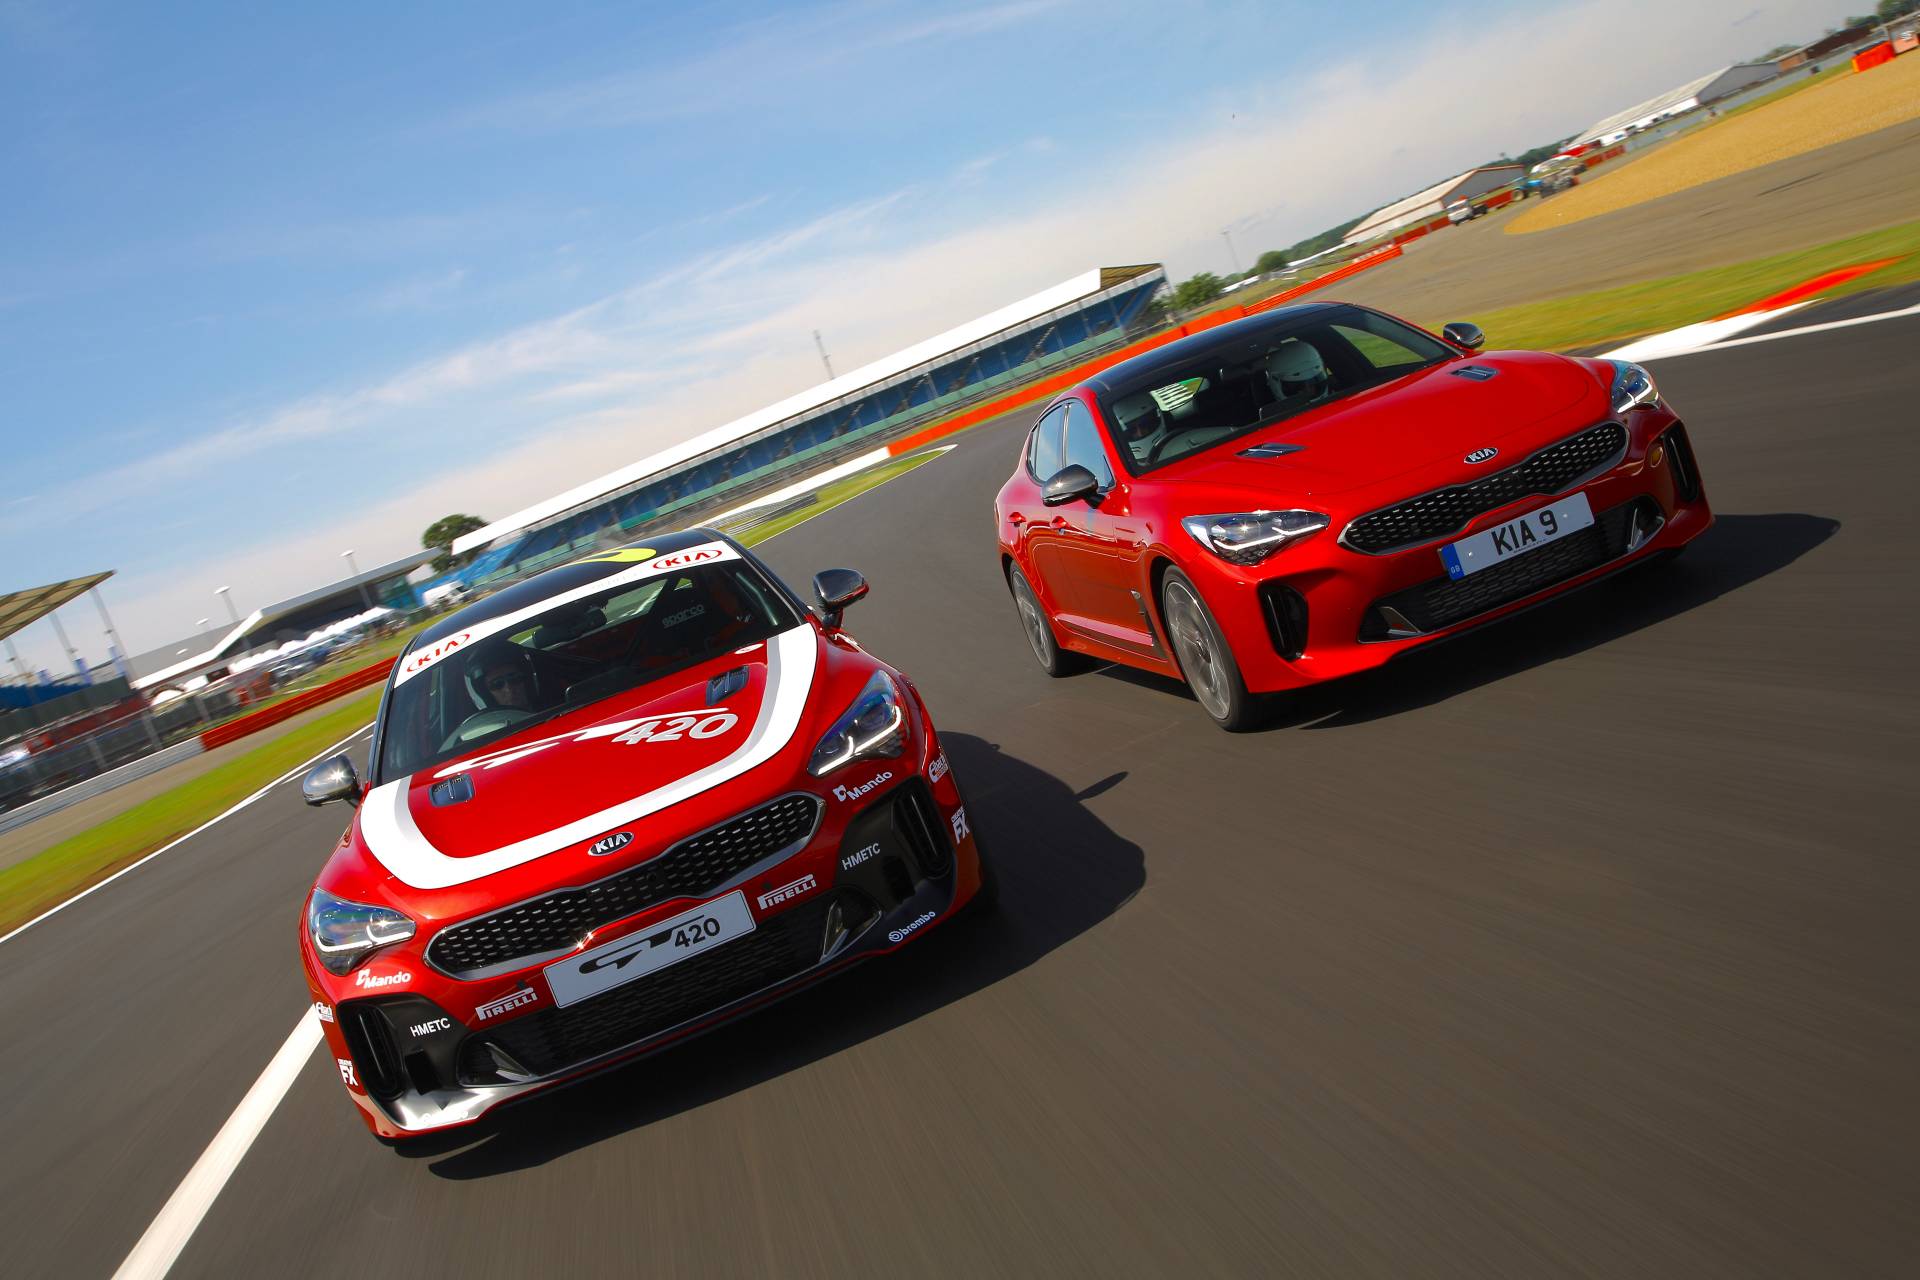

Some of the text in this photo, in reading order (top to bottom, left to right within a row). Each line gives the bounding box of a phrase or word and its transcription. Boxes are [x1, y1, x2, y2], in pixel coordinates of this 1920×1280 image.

[1468, 448, 1495, 462] KIA
[1491, 519, 1536, 556] KIA
[1538, 509, 1558, 535] 9
[666, 552, 710, 567] KIA
[418, 640, 459, 666] KIA
[611, 713, 738, 745] 420
[846, 772, 891, 800] Mando
[594, 833, 628, 853] KIA
[841, 843, 881, 870] HMETC
[757, 873, 817, 910] PIRELLI
[674, 917, 721, 948] 420
[899, 911, 936, 936] brembo
[364, 971, 411, 989] Mando
[475, 987, 538, 1021] PIRELLI
[409, 1018, 451, 1037] HMETC
